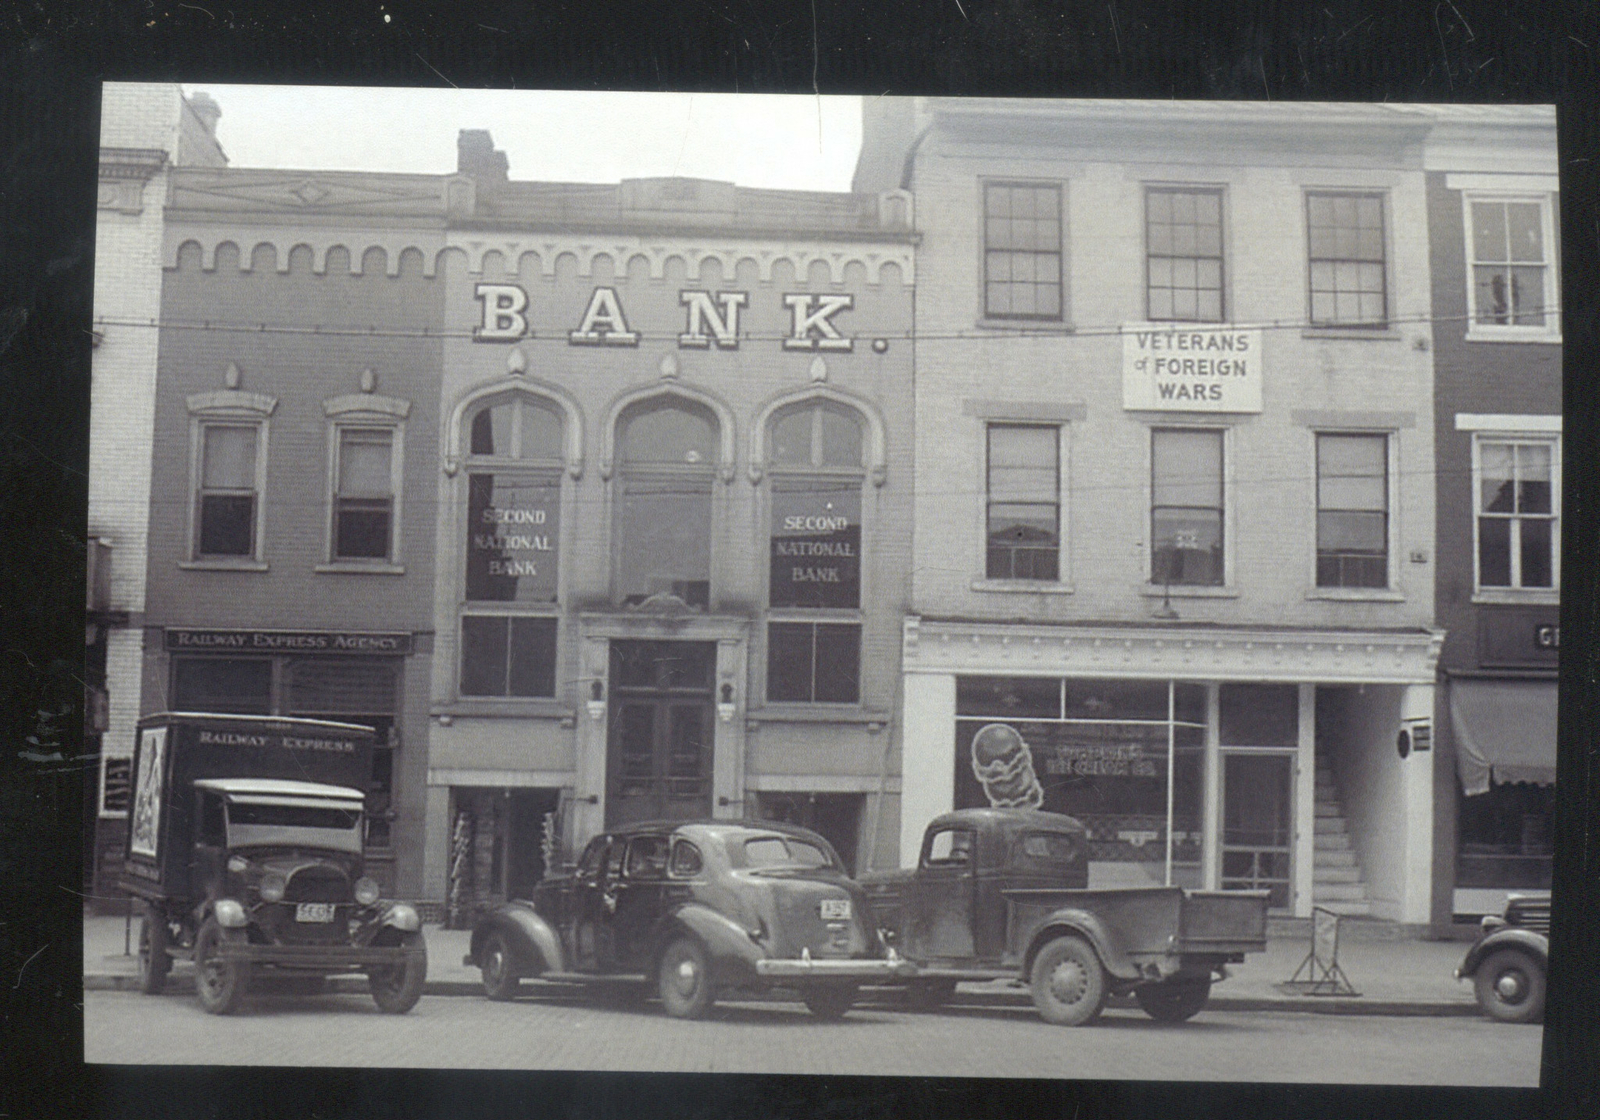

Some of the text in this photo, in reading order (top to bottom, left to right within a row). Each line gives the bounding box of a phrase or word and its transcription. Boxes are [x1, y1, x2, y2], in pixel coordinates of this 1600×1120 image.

[1137, 332, 1249, 351] VETERANS
[1134, 357, 1247, 376] of FOREIGN
[1158, 383, 1223, 400] WARS
[483, 508, 546, 523] SECOND
[783, 516, 847, 530] SECOND
[474, 535, 553, 550] NATIONAL
[776, 542, 854, 556] NATIONAL
[489, 561, 536, 575] BANK
[792, 567, 841, 582] BANK
[178, 632, 399, 649] RAILWAY EXPRESS AGENCY
[199, 731, 355, 752] RAILWAY EXPRESS
